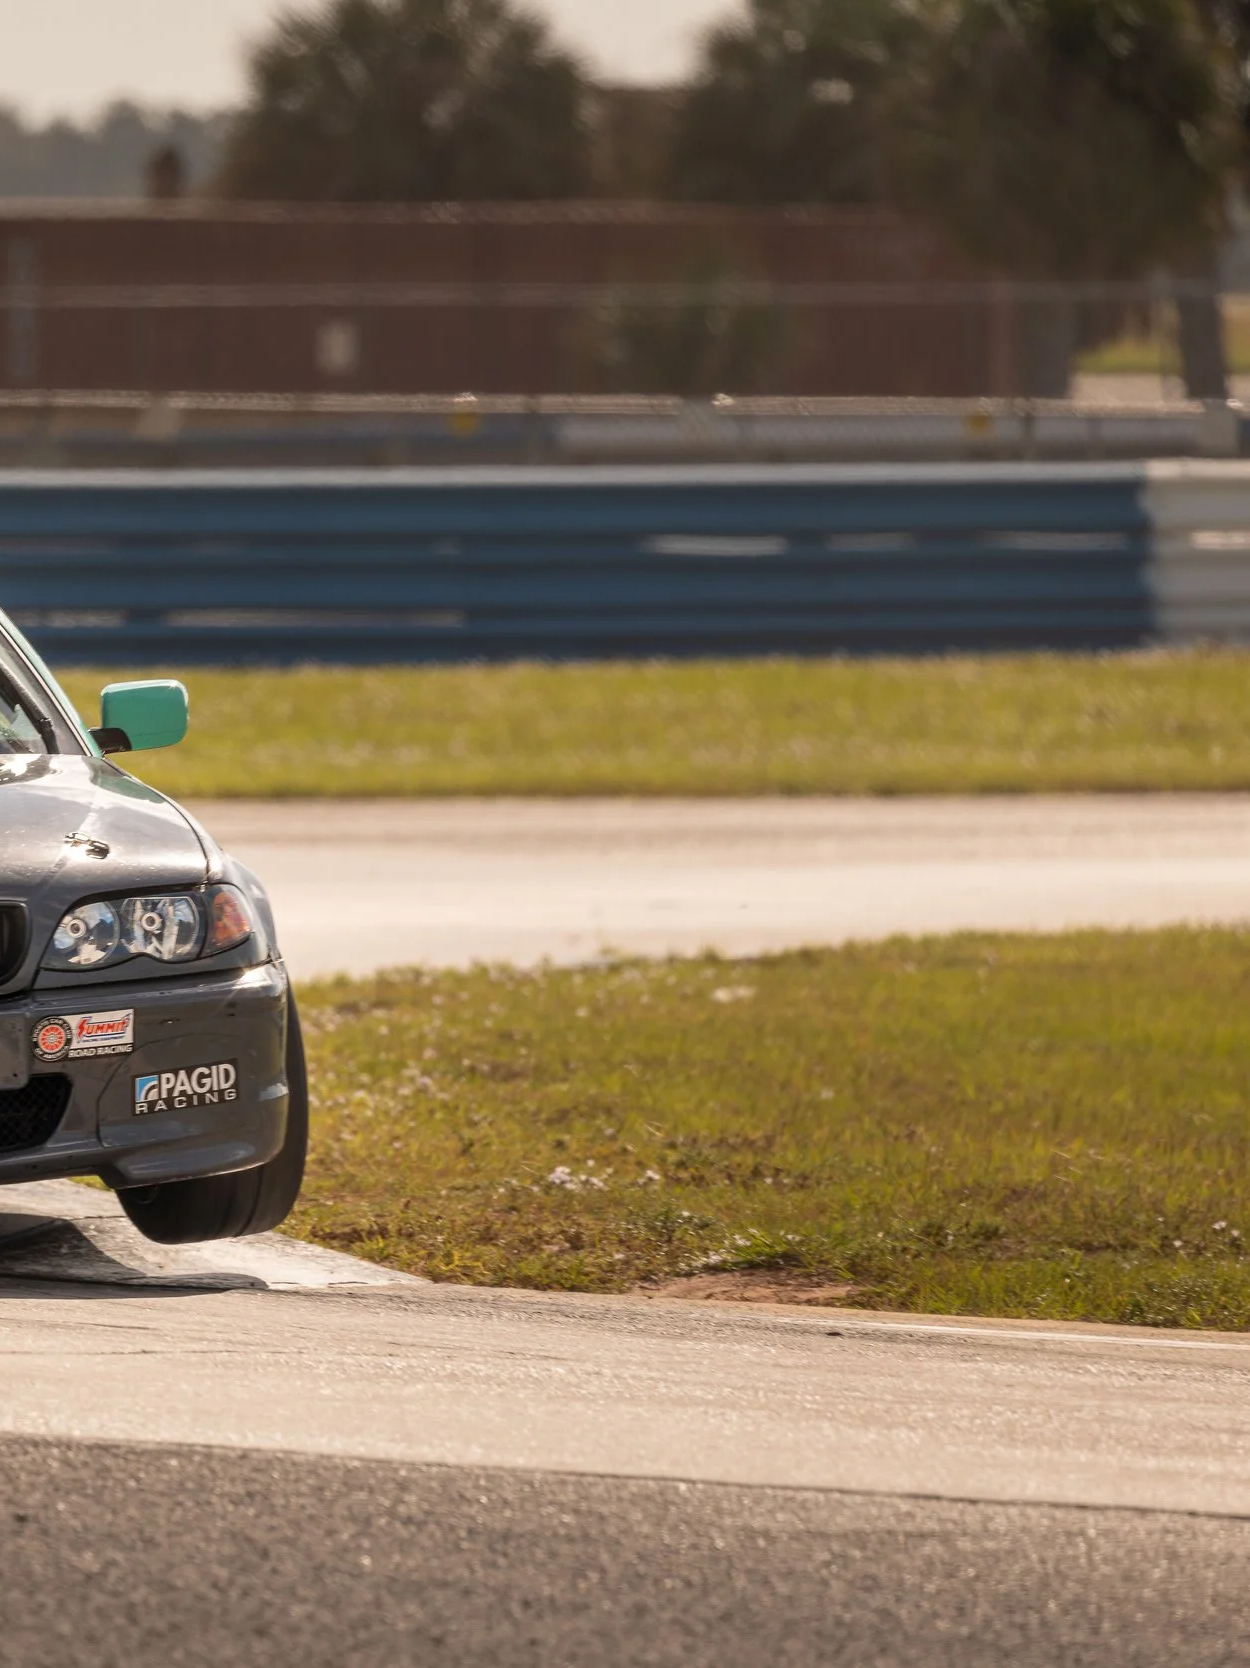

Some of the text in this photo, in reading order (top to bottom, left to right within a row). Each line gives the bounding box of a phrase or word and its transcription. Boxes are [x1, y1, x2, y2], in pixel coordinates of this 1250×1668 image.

[68, 1044, 133, 1058] ROAD RACING
[161, 1063, 236, 1098] PAGID
[135, 1089, 237, 1114] RACING
